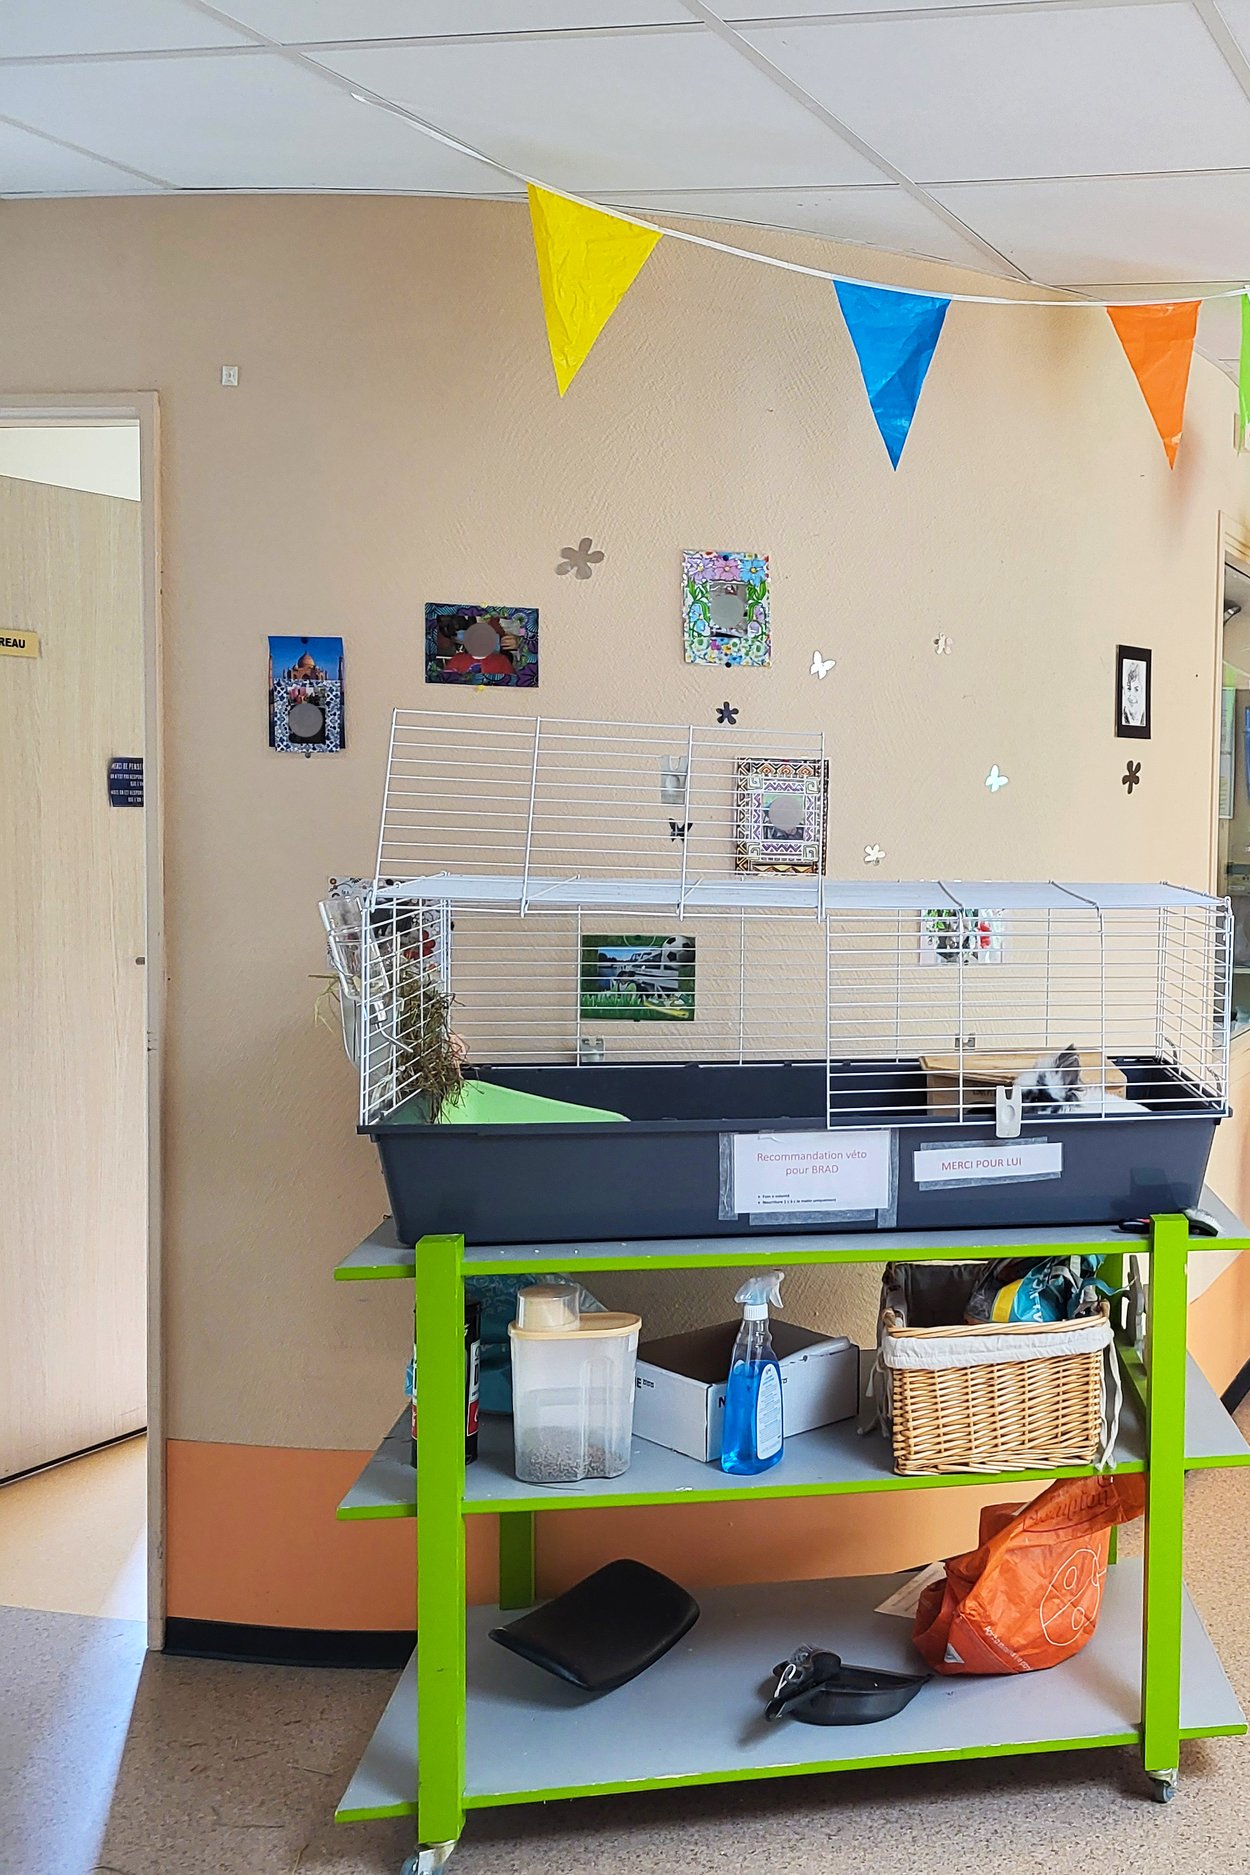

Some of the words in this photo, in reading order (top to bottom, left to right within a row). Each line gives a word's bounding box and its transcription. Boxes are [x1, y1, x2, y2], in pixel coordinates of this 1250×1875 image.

[757, 1151, 844, 1162] Recommandation
[845, 1149, 867, 1160] véto
[786, 1167, 809, 1176] pour
[811, 1165, 839, 1174] BRAD
[941, 1160, 973, 1171] MERCI
[976, 1158, 1004, 1169] POUR
[1006, 1157, 1022, 1167] LUI
